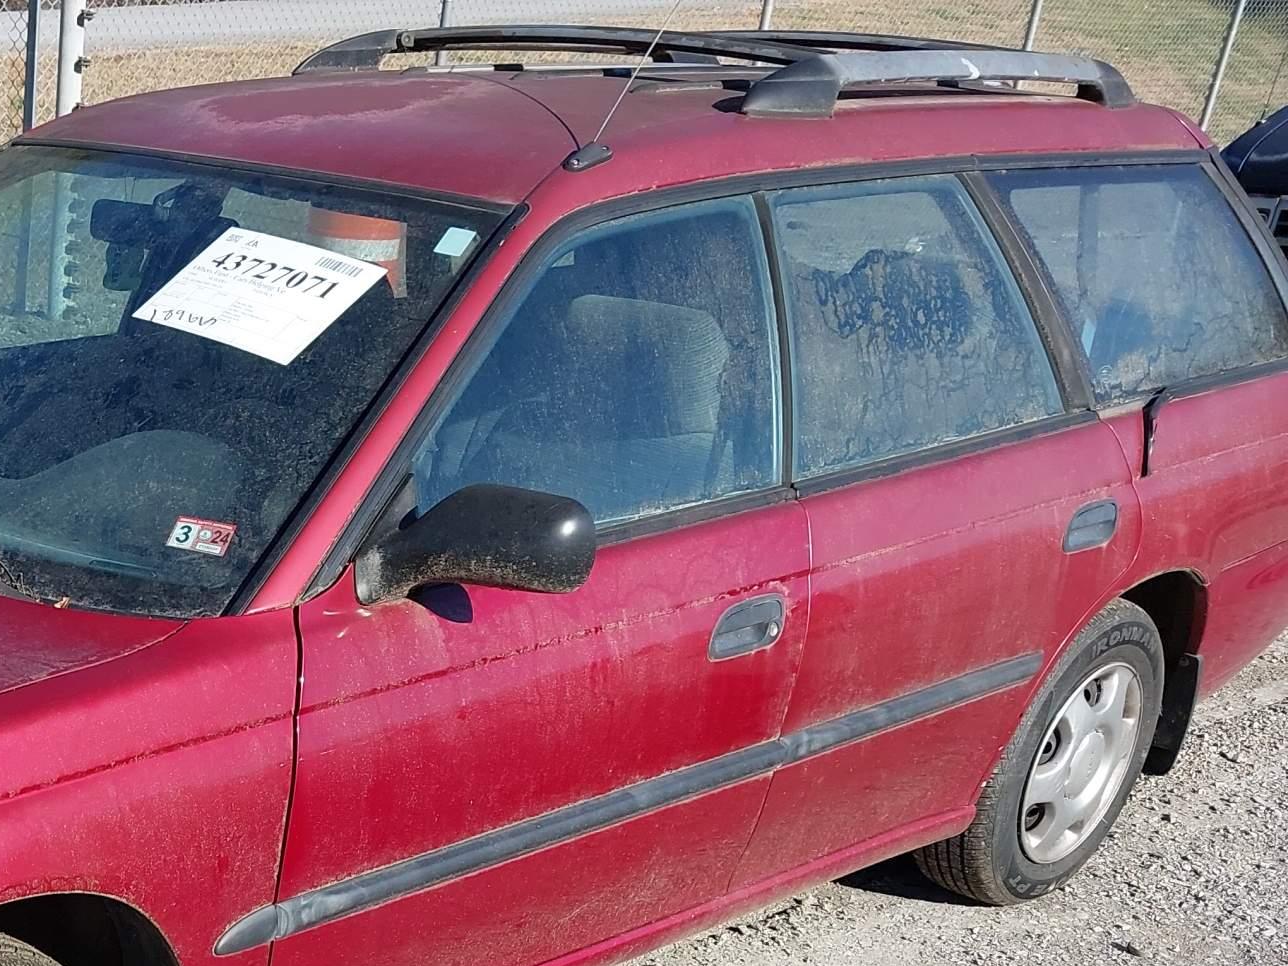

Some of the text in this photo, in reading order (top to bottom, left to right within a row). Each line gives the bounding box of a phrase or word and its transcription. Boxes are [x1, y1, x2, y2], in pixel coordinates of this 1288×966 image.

[212, 252, 340, 299] 43727071
[175, 524, 193, 543] 3
[211, 530, 231, 546] 24
[1092, 626, 1158, 659] IRONMAN
